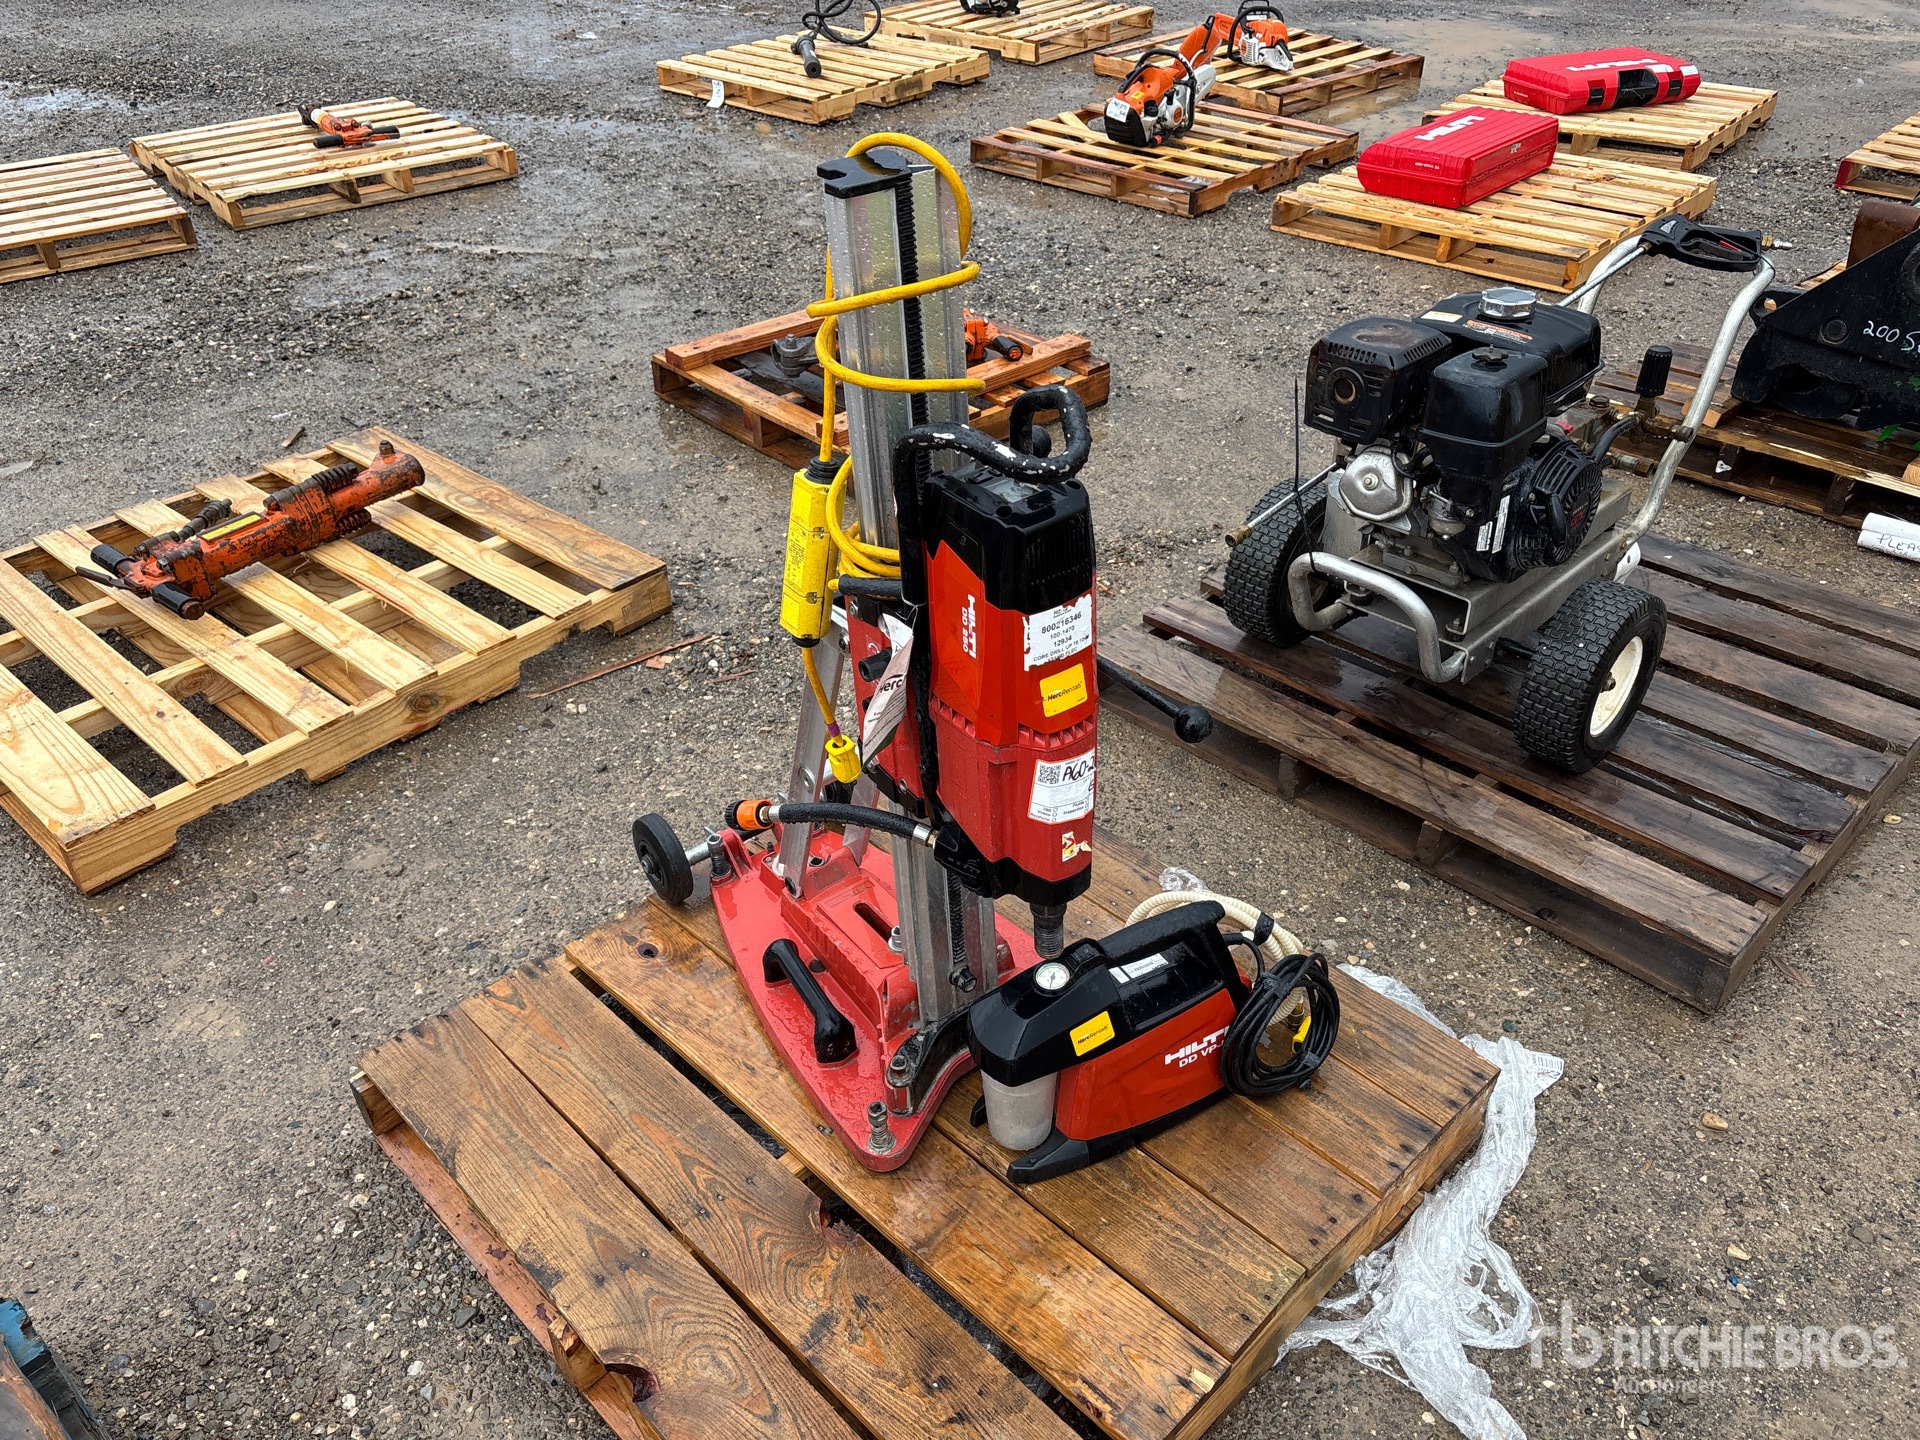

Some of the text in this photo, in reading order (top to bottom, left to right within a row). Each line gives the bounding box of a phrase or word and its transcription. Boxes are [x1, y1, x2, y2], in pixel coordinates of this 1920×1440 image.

[1414, 115, 1486, 141] HILTI
[1862, 320, 1900, 343] 200
[961, 606, 968, 626] DD
[967, 593, 977, 659] HILTI
[1041, 611, 1082, 635] 800216346
[1053, 634, 1072, 648] 12934
[1164, 1025, 1230, 1066] HILTI
[1179, 1053, 1198, 1068] DD
